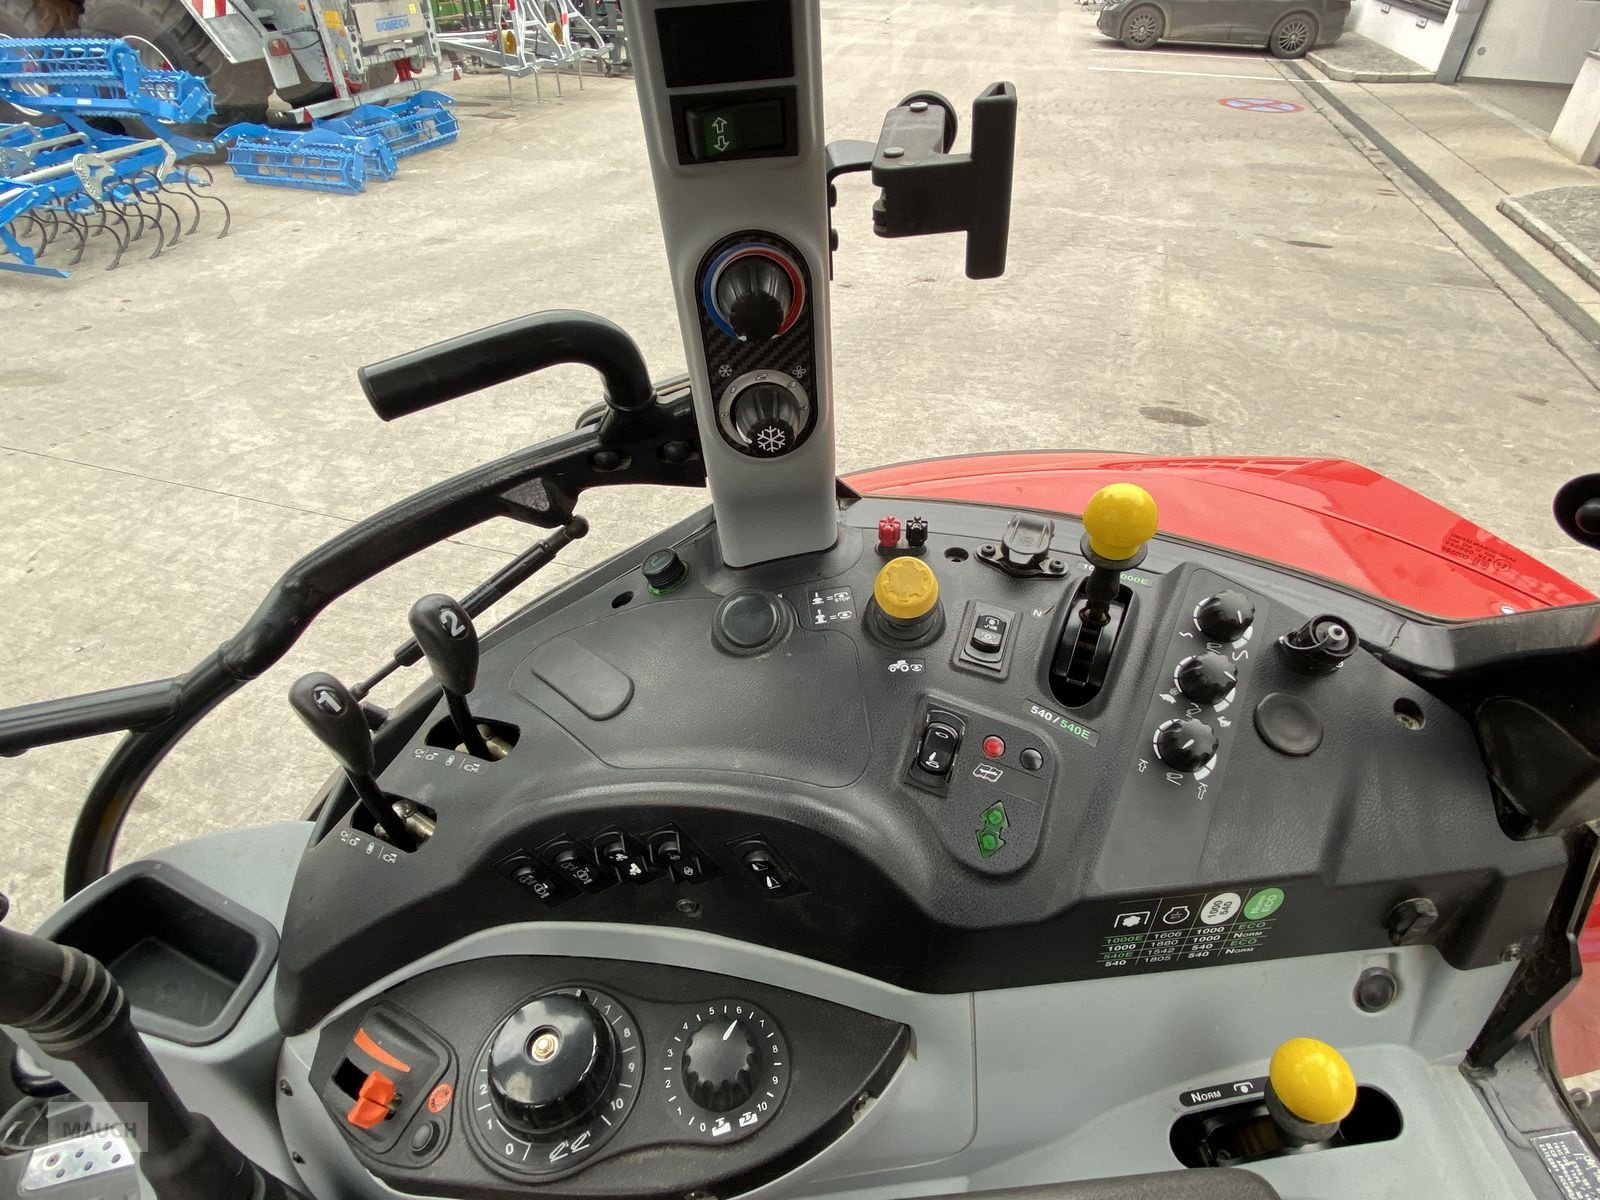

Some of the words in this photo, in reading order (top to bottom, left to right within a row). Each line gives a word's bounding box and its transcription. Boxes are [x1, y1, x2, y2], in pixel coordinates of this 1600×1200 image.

[440, 609, 466, 637] 2
[316, 690, 342, 713] 1
[1219, 901, 1233, 915] 540
[1261, 894, 1277, 912] ECO
[1208, 900, 1222, 918] 1000
[1106, 935, 1143, 944] 1000E
[1154, 932, 1182, 940] 1606
[1197, 927, 1225, 935] 1000
[1238, 922, 1266, 930] ECO
[1108, 944, 1136, 952] 1000
[1193, 935, 1221, 943] 1000
[1103, 952, 1134, 960] 540E
[1191, 943, 1213, 951] 540
[1145, 955, 1171, 963] 1805
[1188, 951, 1209, 959] 540
[604, 1004, 611, 1015] 7
[709, 1007, 715, 1015] 5
[736, 1006, 742, 1014] 6
[682, 1022, 689, 1030] 4
[759, 1020, 765, 1028] 7
[623, 1028, 631, 1037] 8
[667, 1049, 673, 1057] 3
[772, 1045, 778, 1053] 8
[628, 1062, 635, 1072] 9
[665, 1080, 672, 1088] 2
[772, 1076, 779, 1084] 9
[479, 1085, 488, 1095] 2
[611, 1098, 624, 1111] 10
[757, 1102, 768, 1112] 10
[677, 1107, 682, 1116] 1
[486, 1120, 492, 1130] 1
[700, 1122, 706, 1132] 0
[505, 1143, 514, 1154] 0
